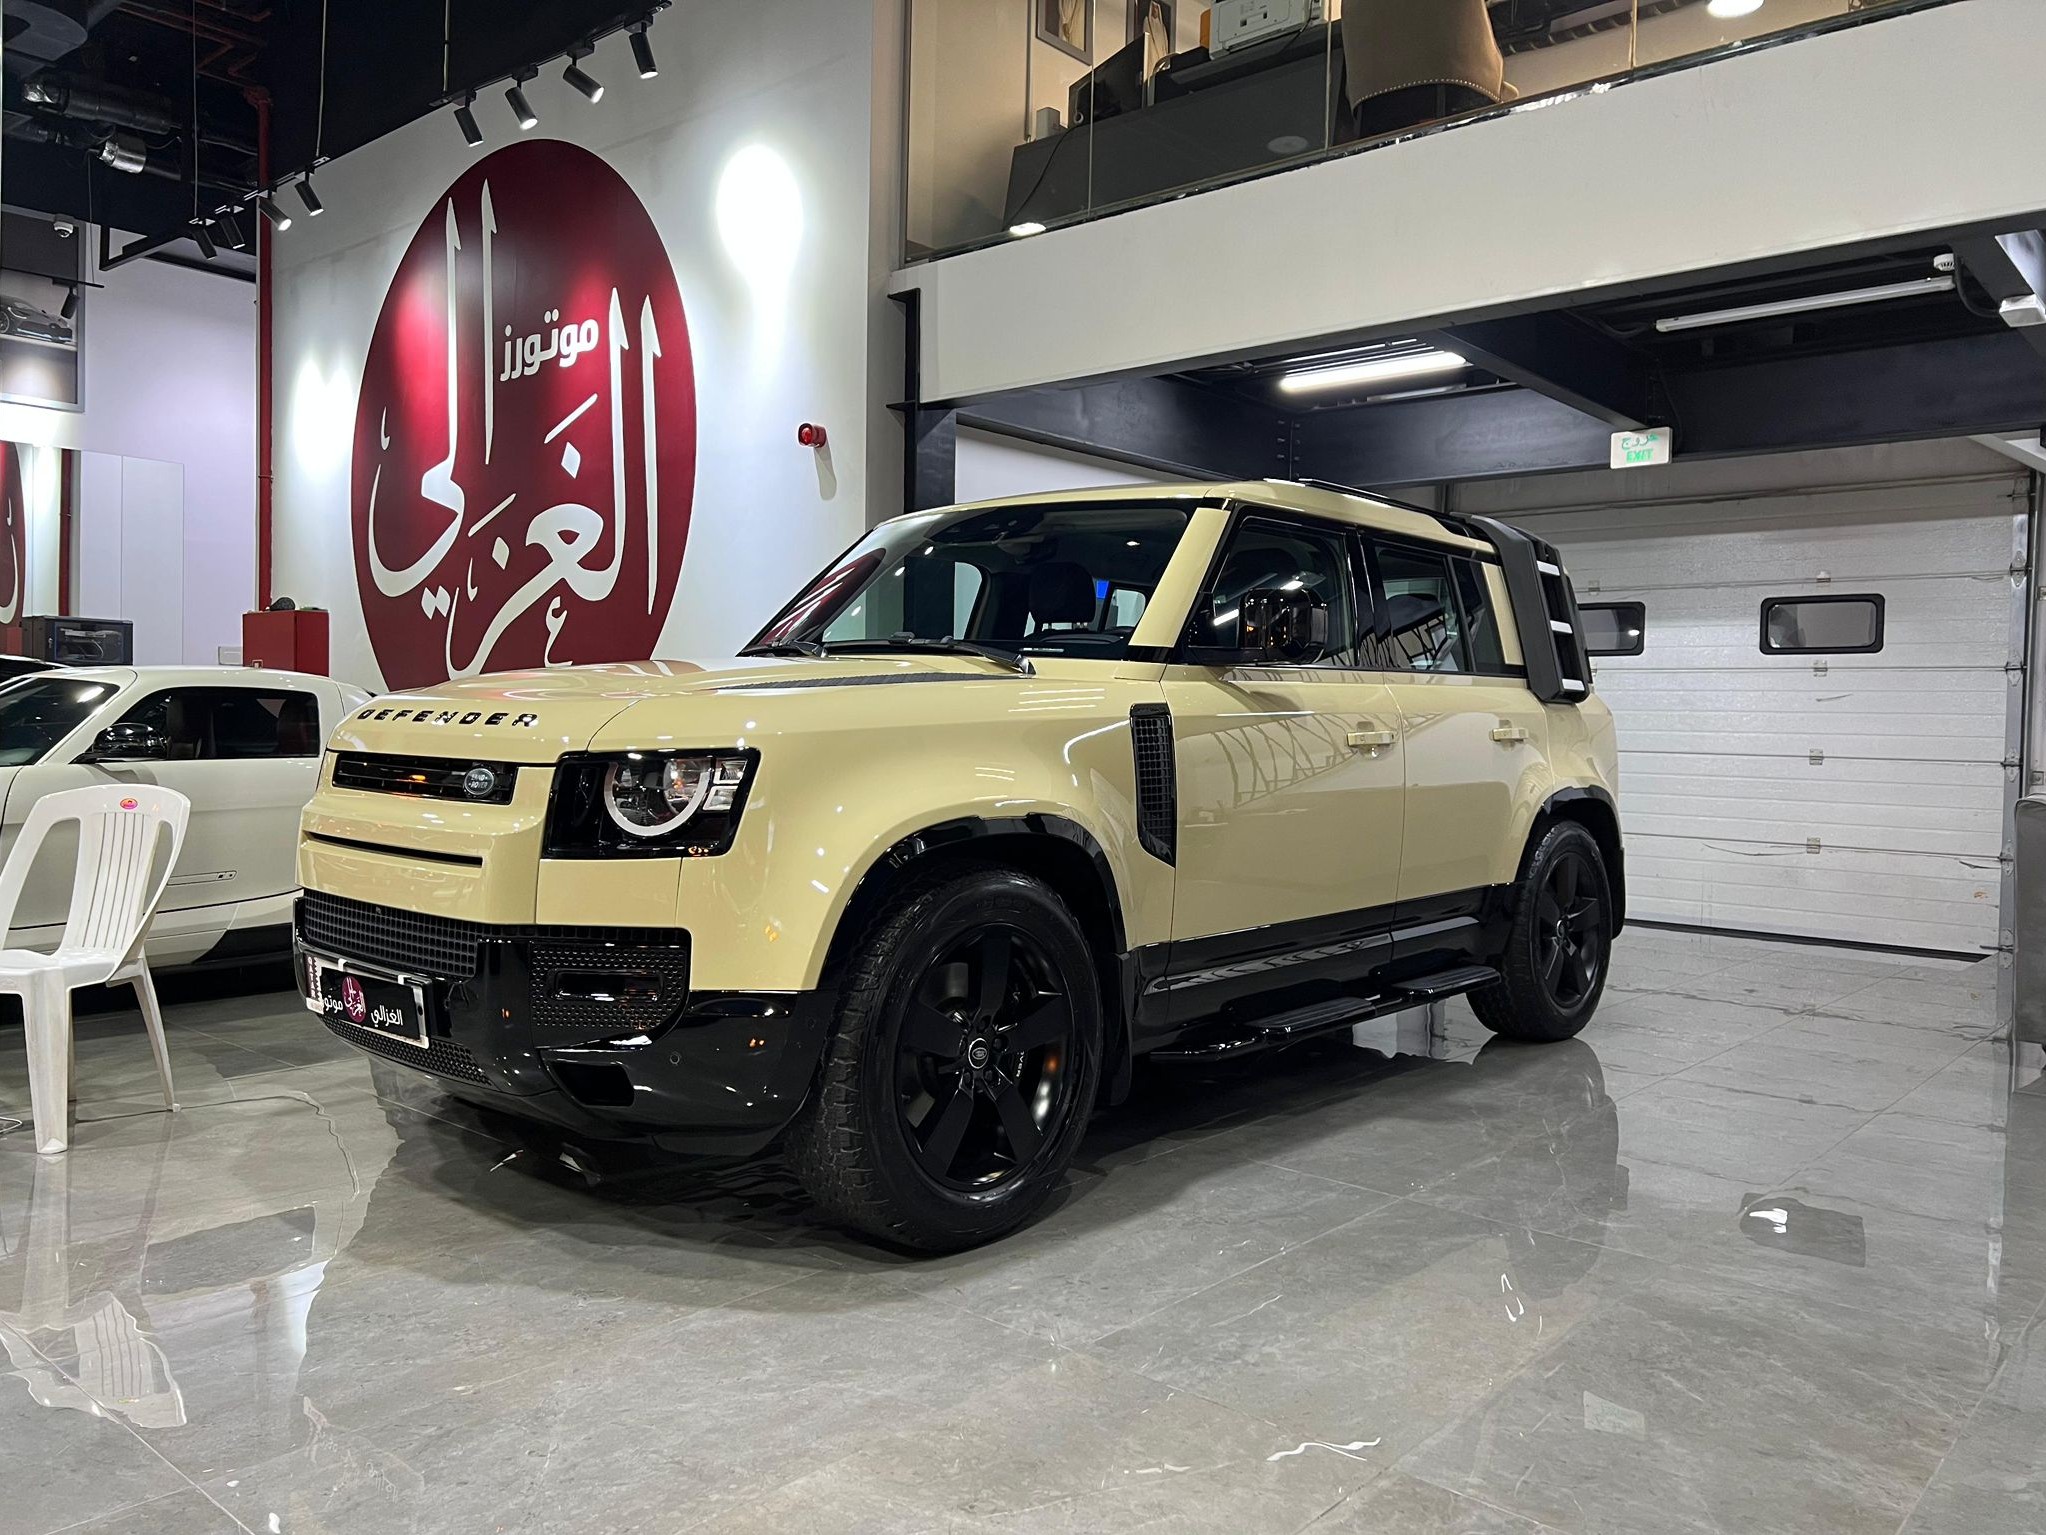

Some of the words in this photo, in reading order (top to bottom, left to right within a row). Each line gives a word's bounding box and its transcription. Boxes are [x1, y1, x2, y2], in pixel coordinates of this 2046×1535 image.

[500, 309, 599, 381] موتورز
[1626, 449, 1653, 463] EXIT
[357, 709, 538, 727] DEFENDER
[371, 1005, 403, 1028] الغزالي
